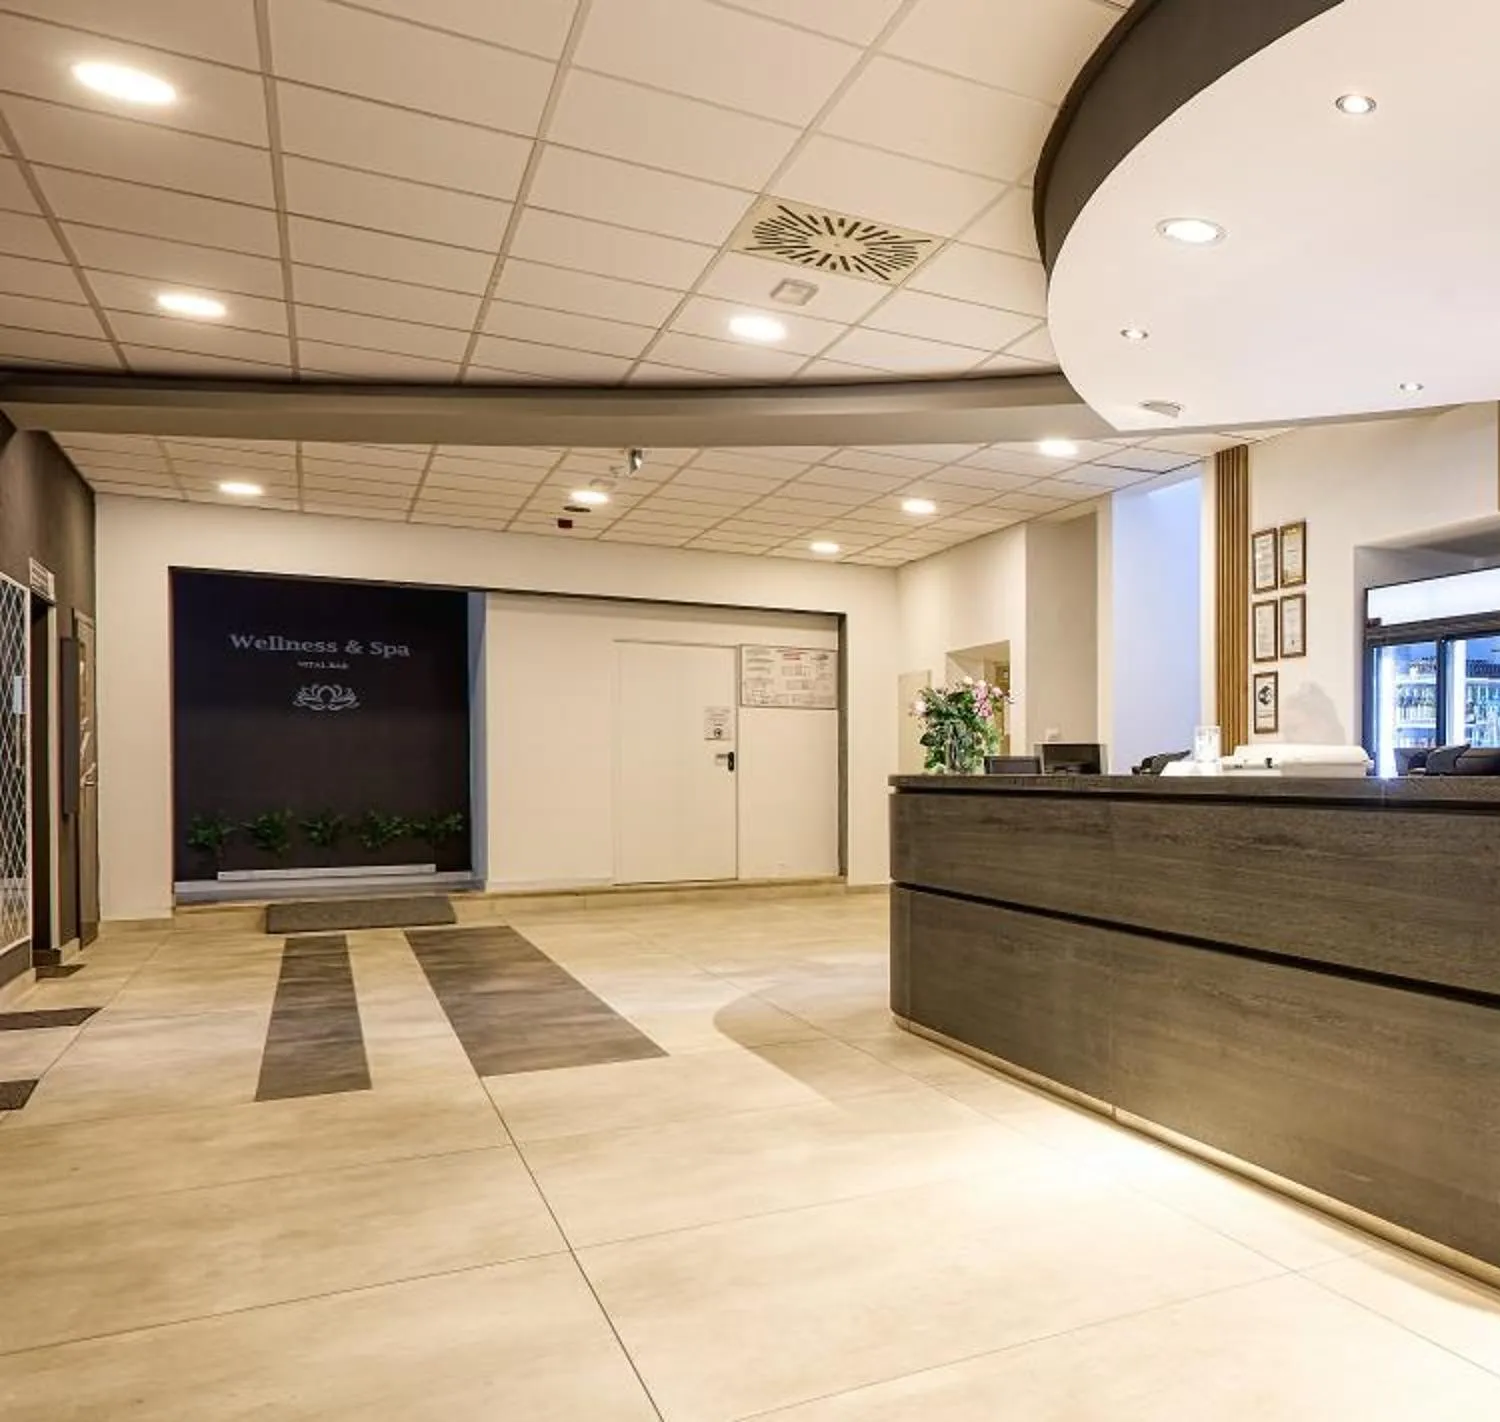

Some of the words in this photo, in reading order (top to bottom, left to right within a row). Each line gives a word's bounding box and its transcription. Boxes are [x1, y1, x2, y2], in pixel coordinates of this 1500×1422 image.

[229, 633, 339, 653] Wellness
[344, 639, 364, 655] &
[369, 641, 411, 659] Spa
